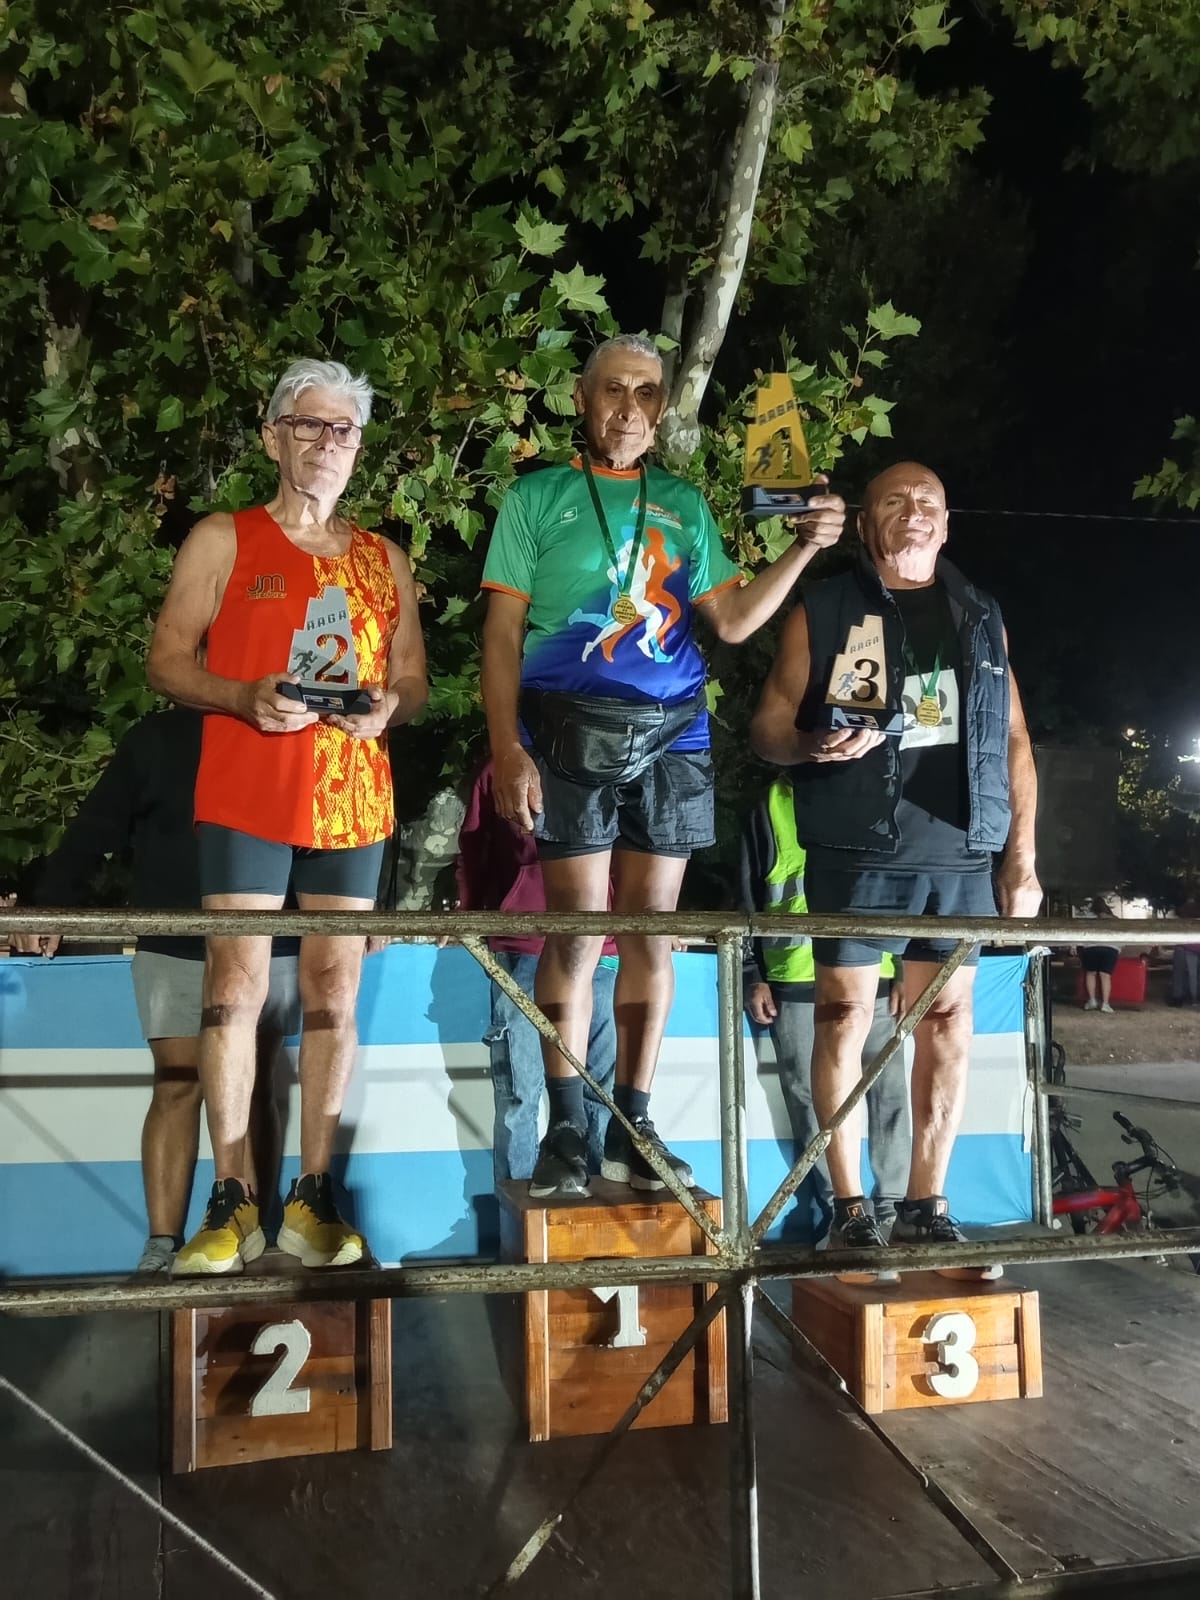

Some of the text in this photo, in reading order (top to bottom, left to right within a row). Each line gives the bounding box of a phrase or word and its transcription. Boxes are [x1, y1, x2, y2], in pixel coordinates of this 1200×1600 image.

[769, 426, 802, 480] 1
[314, 633, 350, 685] 2
[850, 658, 880, 703] 3
[588, 1285, 647, 1348] 1
[249, 1319, 312, 1417] 2
[921, 1310, 979, 1399] 3
